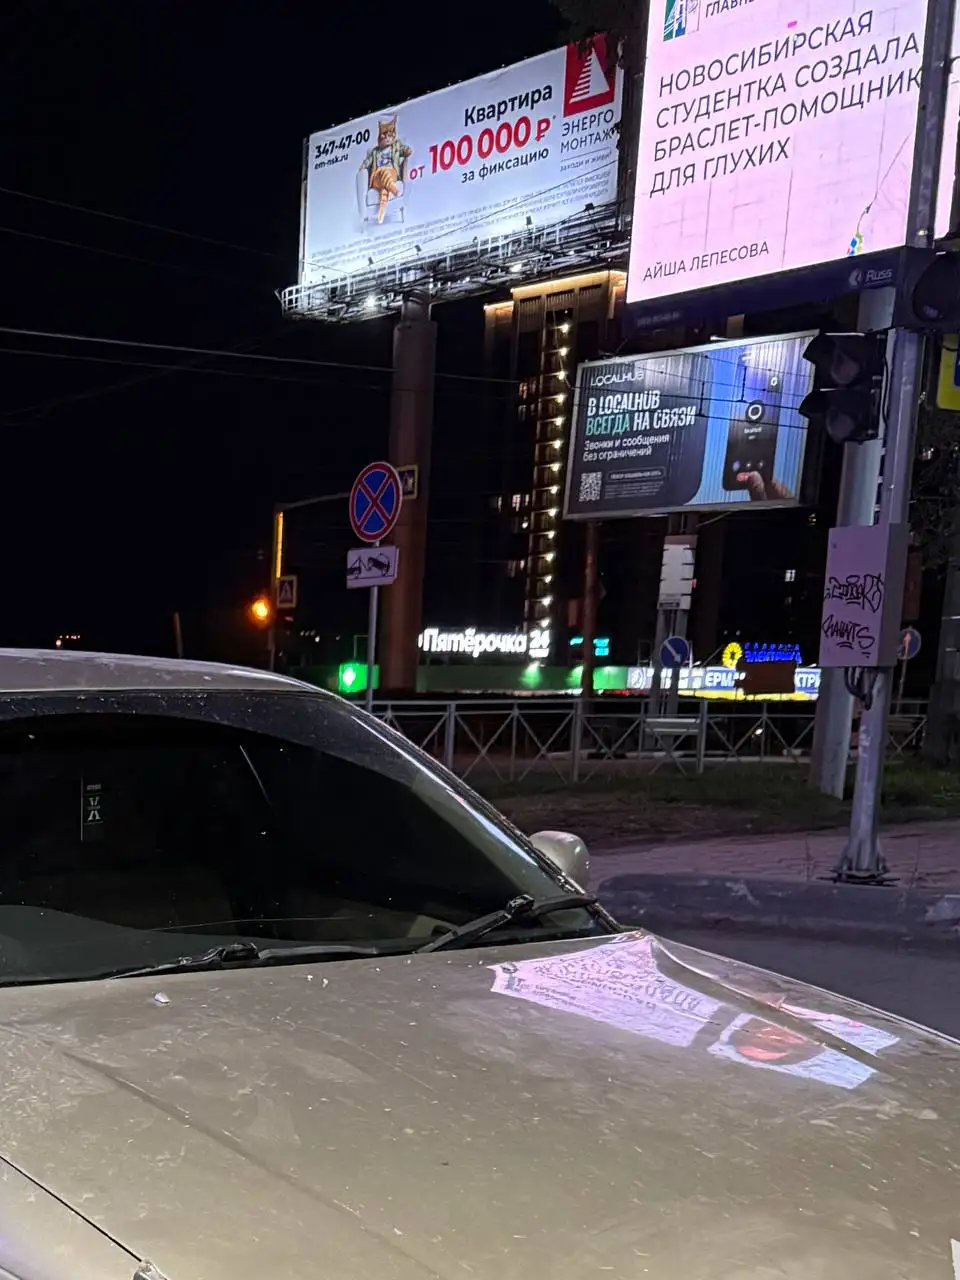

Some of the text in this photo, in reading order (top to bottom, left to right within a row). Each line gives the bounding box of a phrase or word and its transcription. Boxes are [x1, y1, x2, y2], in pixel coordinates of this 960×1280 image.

[705, 0, 754, 18] ГЛАВ
[659, 10, 873, 98] НОВОСИБИРСКАЯ
[656, 32, 919, 128] СТУДЕНТКА СОЗДАЛА
[464, 84, 553, 127] Квартира
[654, 67, 922, 162] БРАСЛЕТ-ПОМОЩНИК
[561, 109, 614, 137] ЭНЕРГО
[560, 127, 613, 153] МОНТАЖ
[410, 166, 425, 180] от
[429, 134, 473, 175] 100
[461, 148, 549, 183] за фиксацию
[650, 137, 791, 198] ДЛЯ ГЛУХИХ
[643, 240, 770, 282] АЙША ЛЕПЕСОВА
[588, 390, 660, 416] В LOCALHUB
[586, 406, 696, 436] ВСЕГДА НА СВЯЗИ
[583, 446, 653, 461] без ограничений
[584, 434, 670, 451] Звонки и сообщения
[424, 628, 527, 657] Пятёрочка
